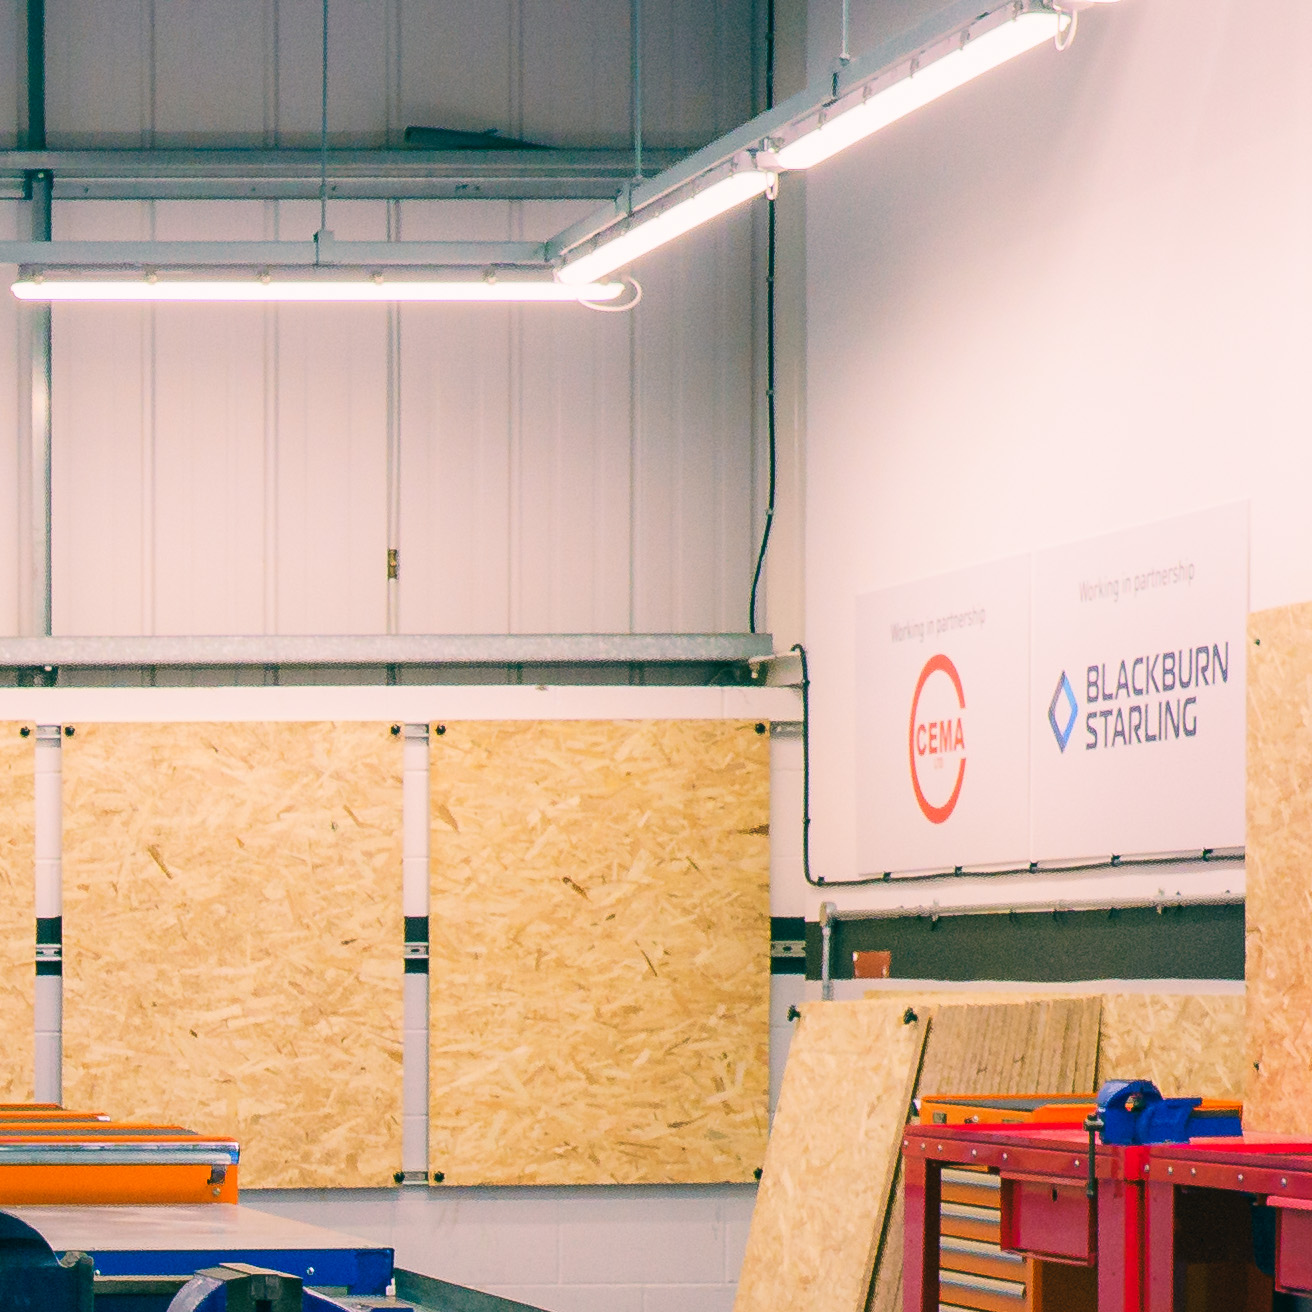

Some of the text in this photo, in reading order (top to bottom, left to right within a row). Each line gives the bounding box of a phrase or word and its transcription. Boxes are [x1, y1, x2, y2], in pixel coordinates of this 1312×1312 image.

[1079, 559, 1195, 602] Working in partnership
[890, 605, 986, 643] Working in partnership
[1086, 641, 1230, 703] BLACKBURN
[916, 716, 966, 757] CEMA
[1085, 696, 1198, 751] STARLING
